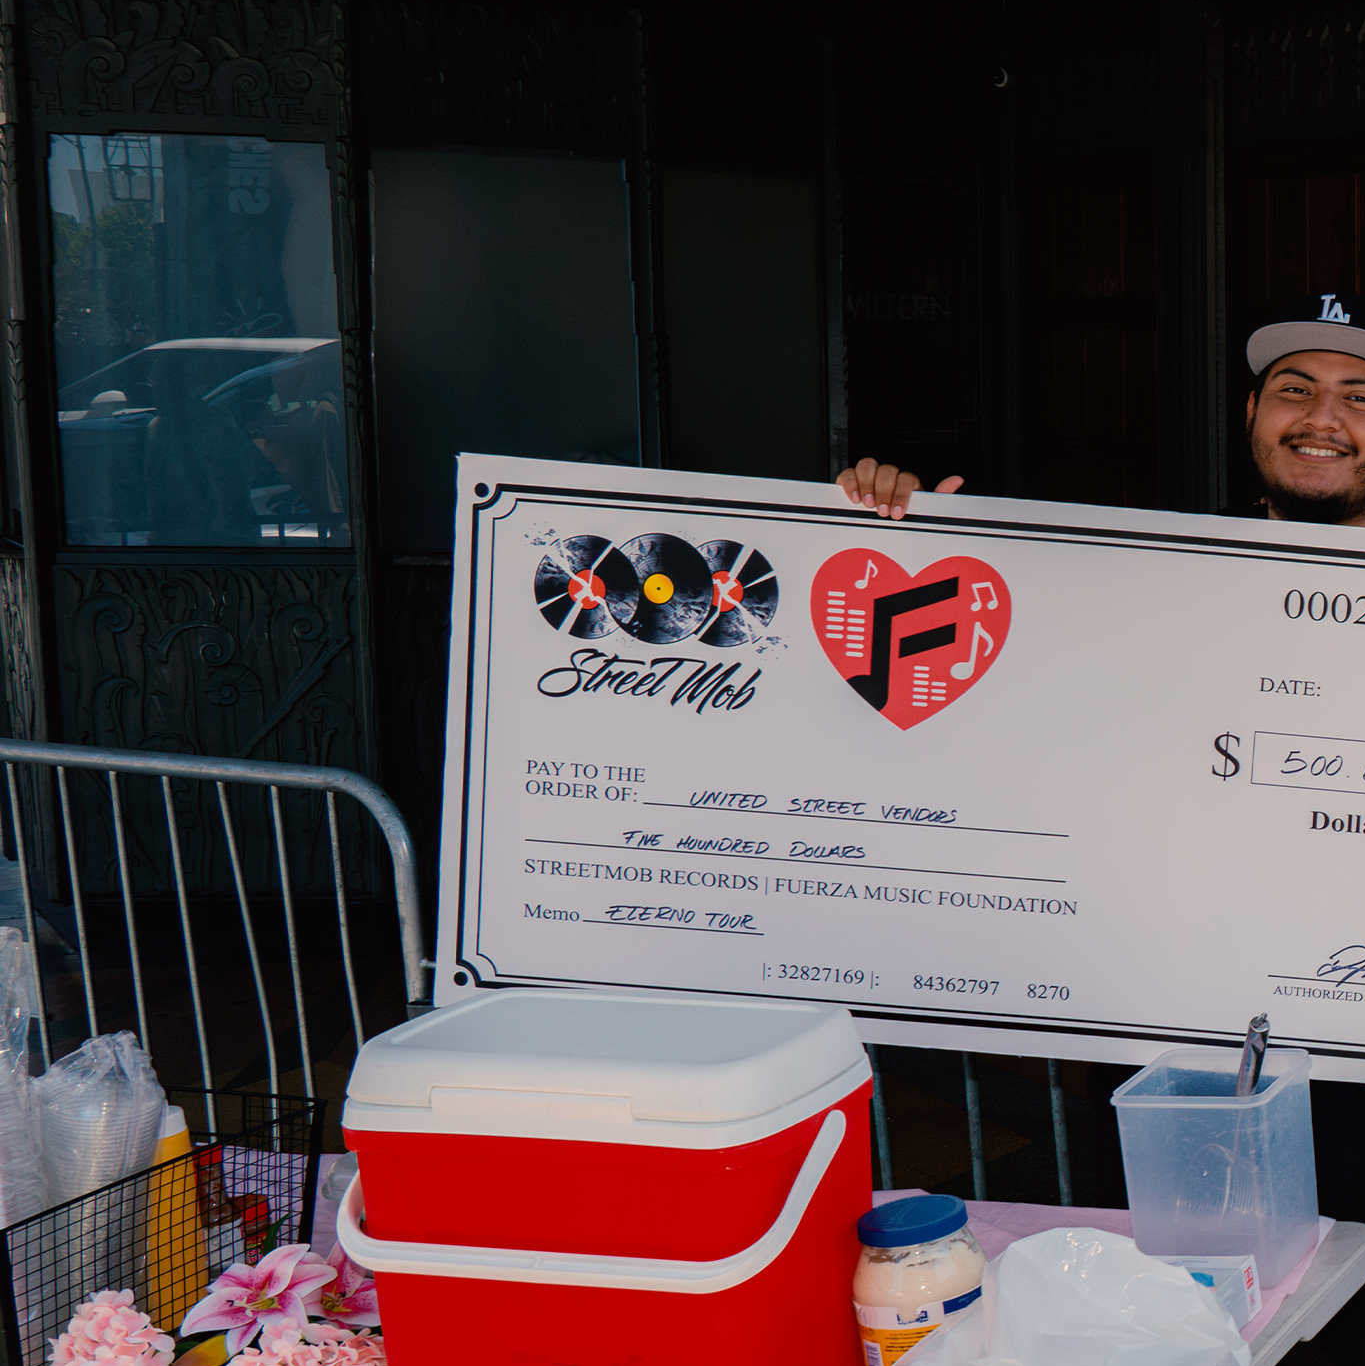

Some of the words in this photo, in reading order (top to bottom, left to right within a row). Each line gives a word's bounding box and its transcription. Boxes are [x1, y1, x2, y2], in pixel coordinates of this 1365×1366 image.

[537, 648, 698, 698] Street
[669, 661, 763, 715] Mob
[1259, 677, 1322, 698] DATE:
[526, 760, 566, 776] PAY
[571, 763, 598, 780] TO
[604, 766, 646, 783] THE
[1211, 731, 1242, 782] $
[525, 780, 599, 800] ORDER
[604, 786, 638, 803] OF:
[690, 790, 767, 809] UNITED
[787, 798, 867, 816] STREET
[622, 830, 664, 847] FIVE
[676, 835, 769, 855] HOUNDRED
[524, 858, 653, 883] STREETMOB
[659, 869, 759, 891] RECORDS
[773, 878, 858, 900] FUERZA
[863, 885, 932, 905] MUSIC
[937, 891, 1079, 916] FOUNDATION
[523, 903, 580, 922] Memo
[705, 912, 757, 930] TOUR
[778, 964, 865, 985] 32827169
[913, 974, 1000, 996] 84362797
[1027, 984, 1070, 1002] 8270
[1273, 984, 1364, 1004] AUTHORIZED
